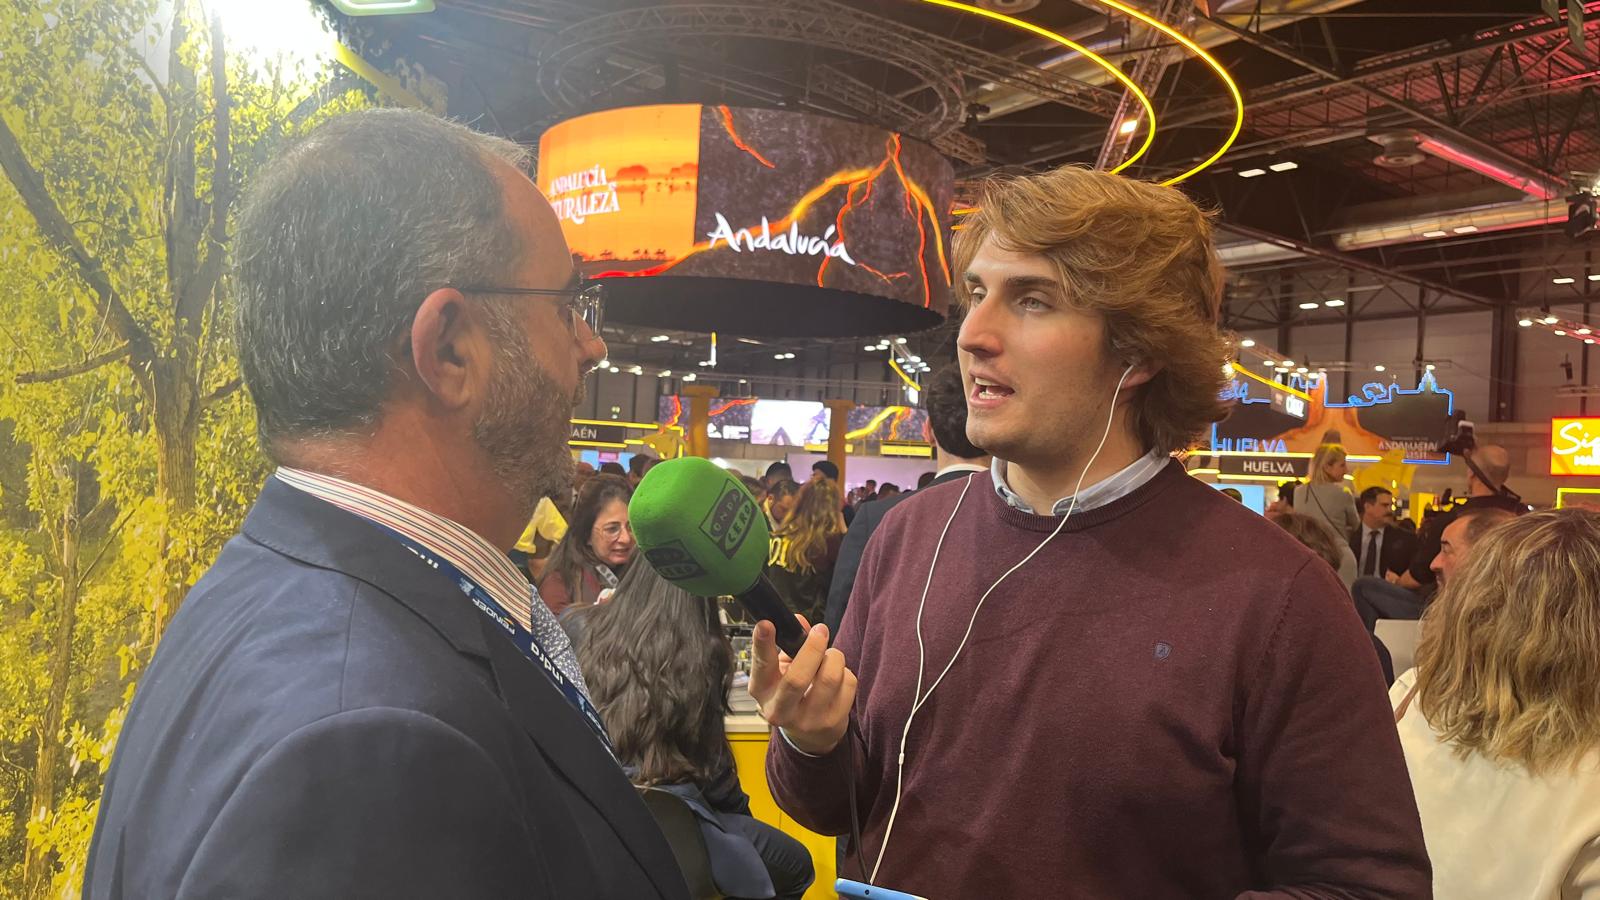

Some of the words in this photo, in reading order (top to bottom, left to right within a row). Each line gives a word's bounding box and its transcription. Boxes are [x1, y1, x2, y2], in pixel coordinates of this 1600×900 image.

[706, 211, 857, 266] Andalucía
[1242, 460, 1295, 474] HUELVA
[712, 489, 739, 531] ONDA
[727, 504, 751, 543] CERO
[530, 641, 564, 685] indra
